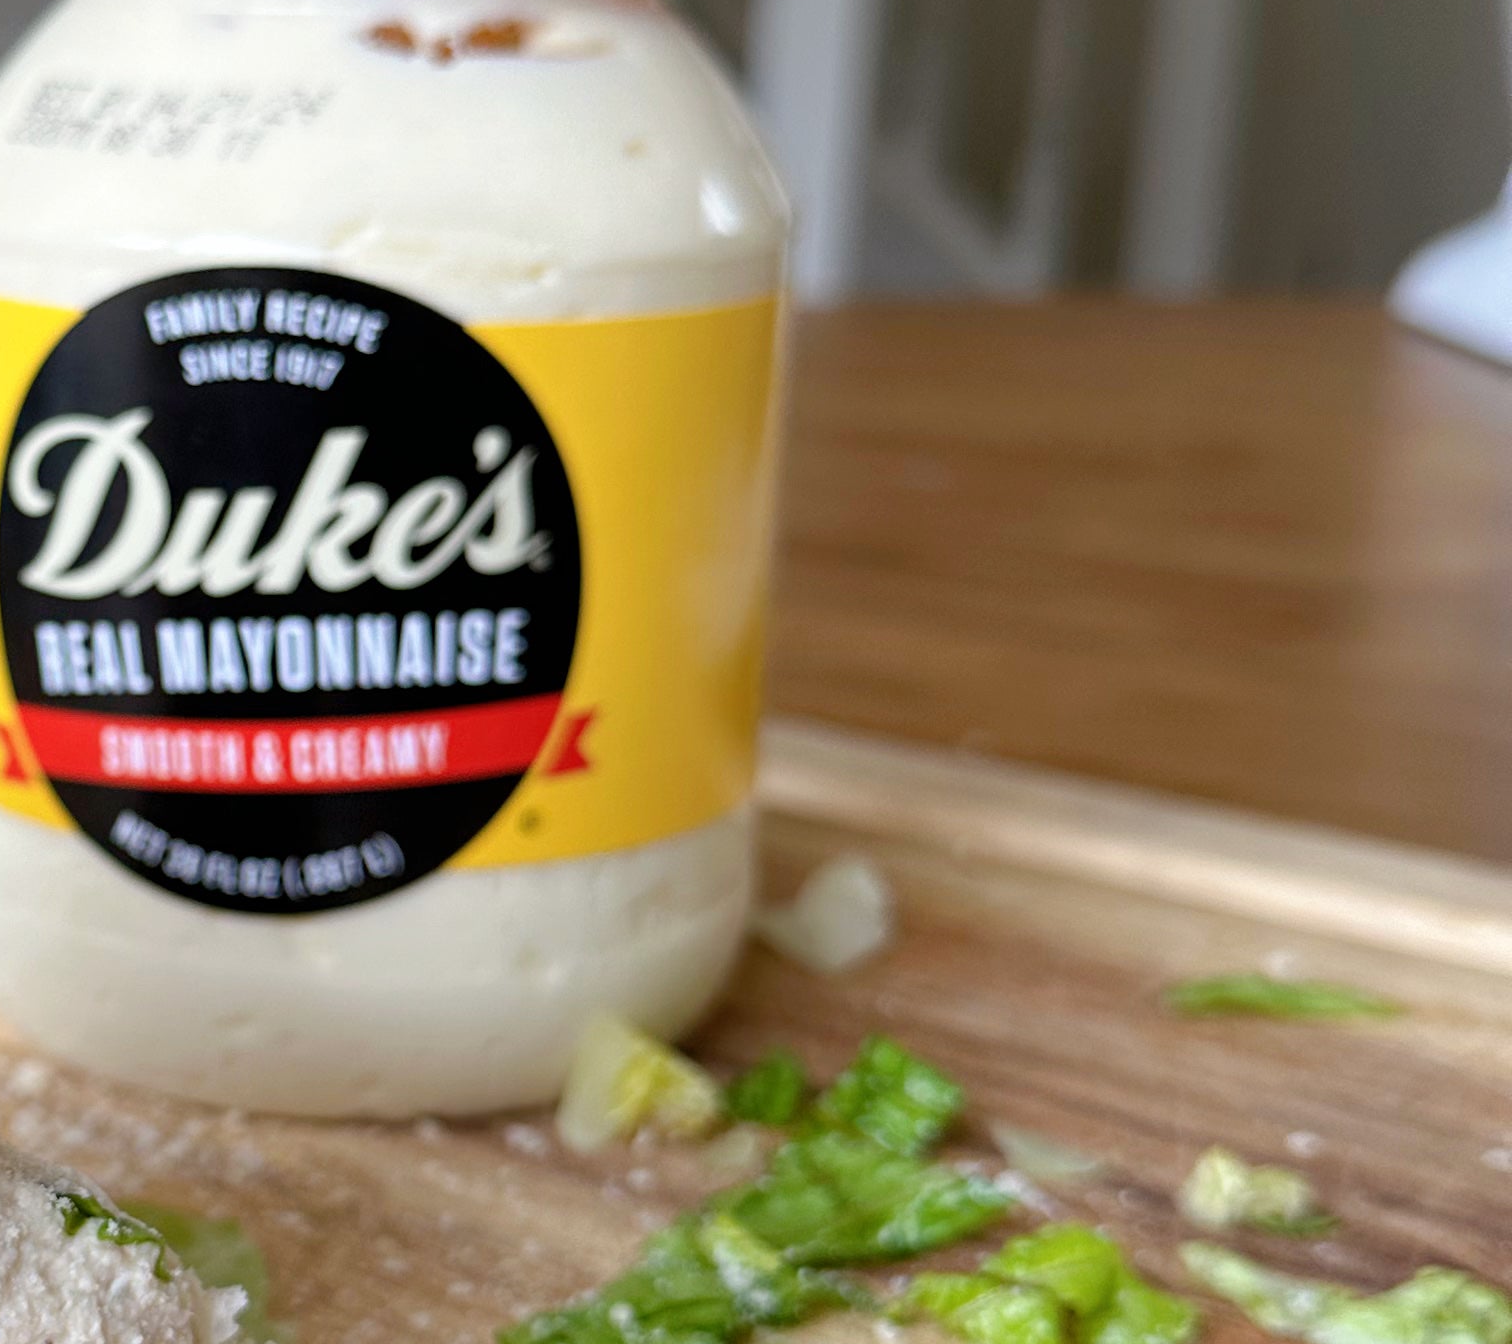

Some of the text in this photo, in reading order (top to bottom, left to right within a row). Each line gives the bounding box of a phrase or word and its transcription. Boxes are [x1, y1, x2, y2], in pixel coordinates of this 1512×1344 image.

[144, 288, 389, 354] FAMILY RECIPE
[179, 339, 273, 386] SINCE
[8, 407, 539, 600] Duke's
[35, 607, 530, 696] REAL MAYONNAISE
[99, 721, 450, 783] SMOOTH & CREAMY
